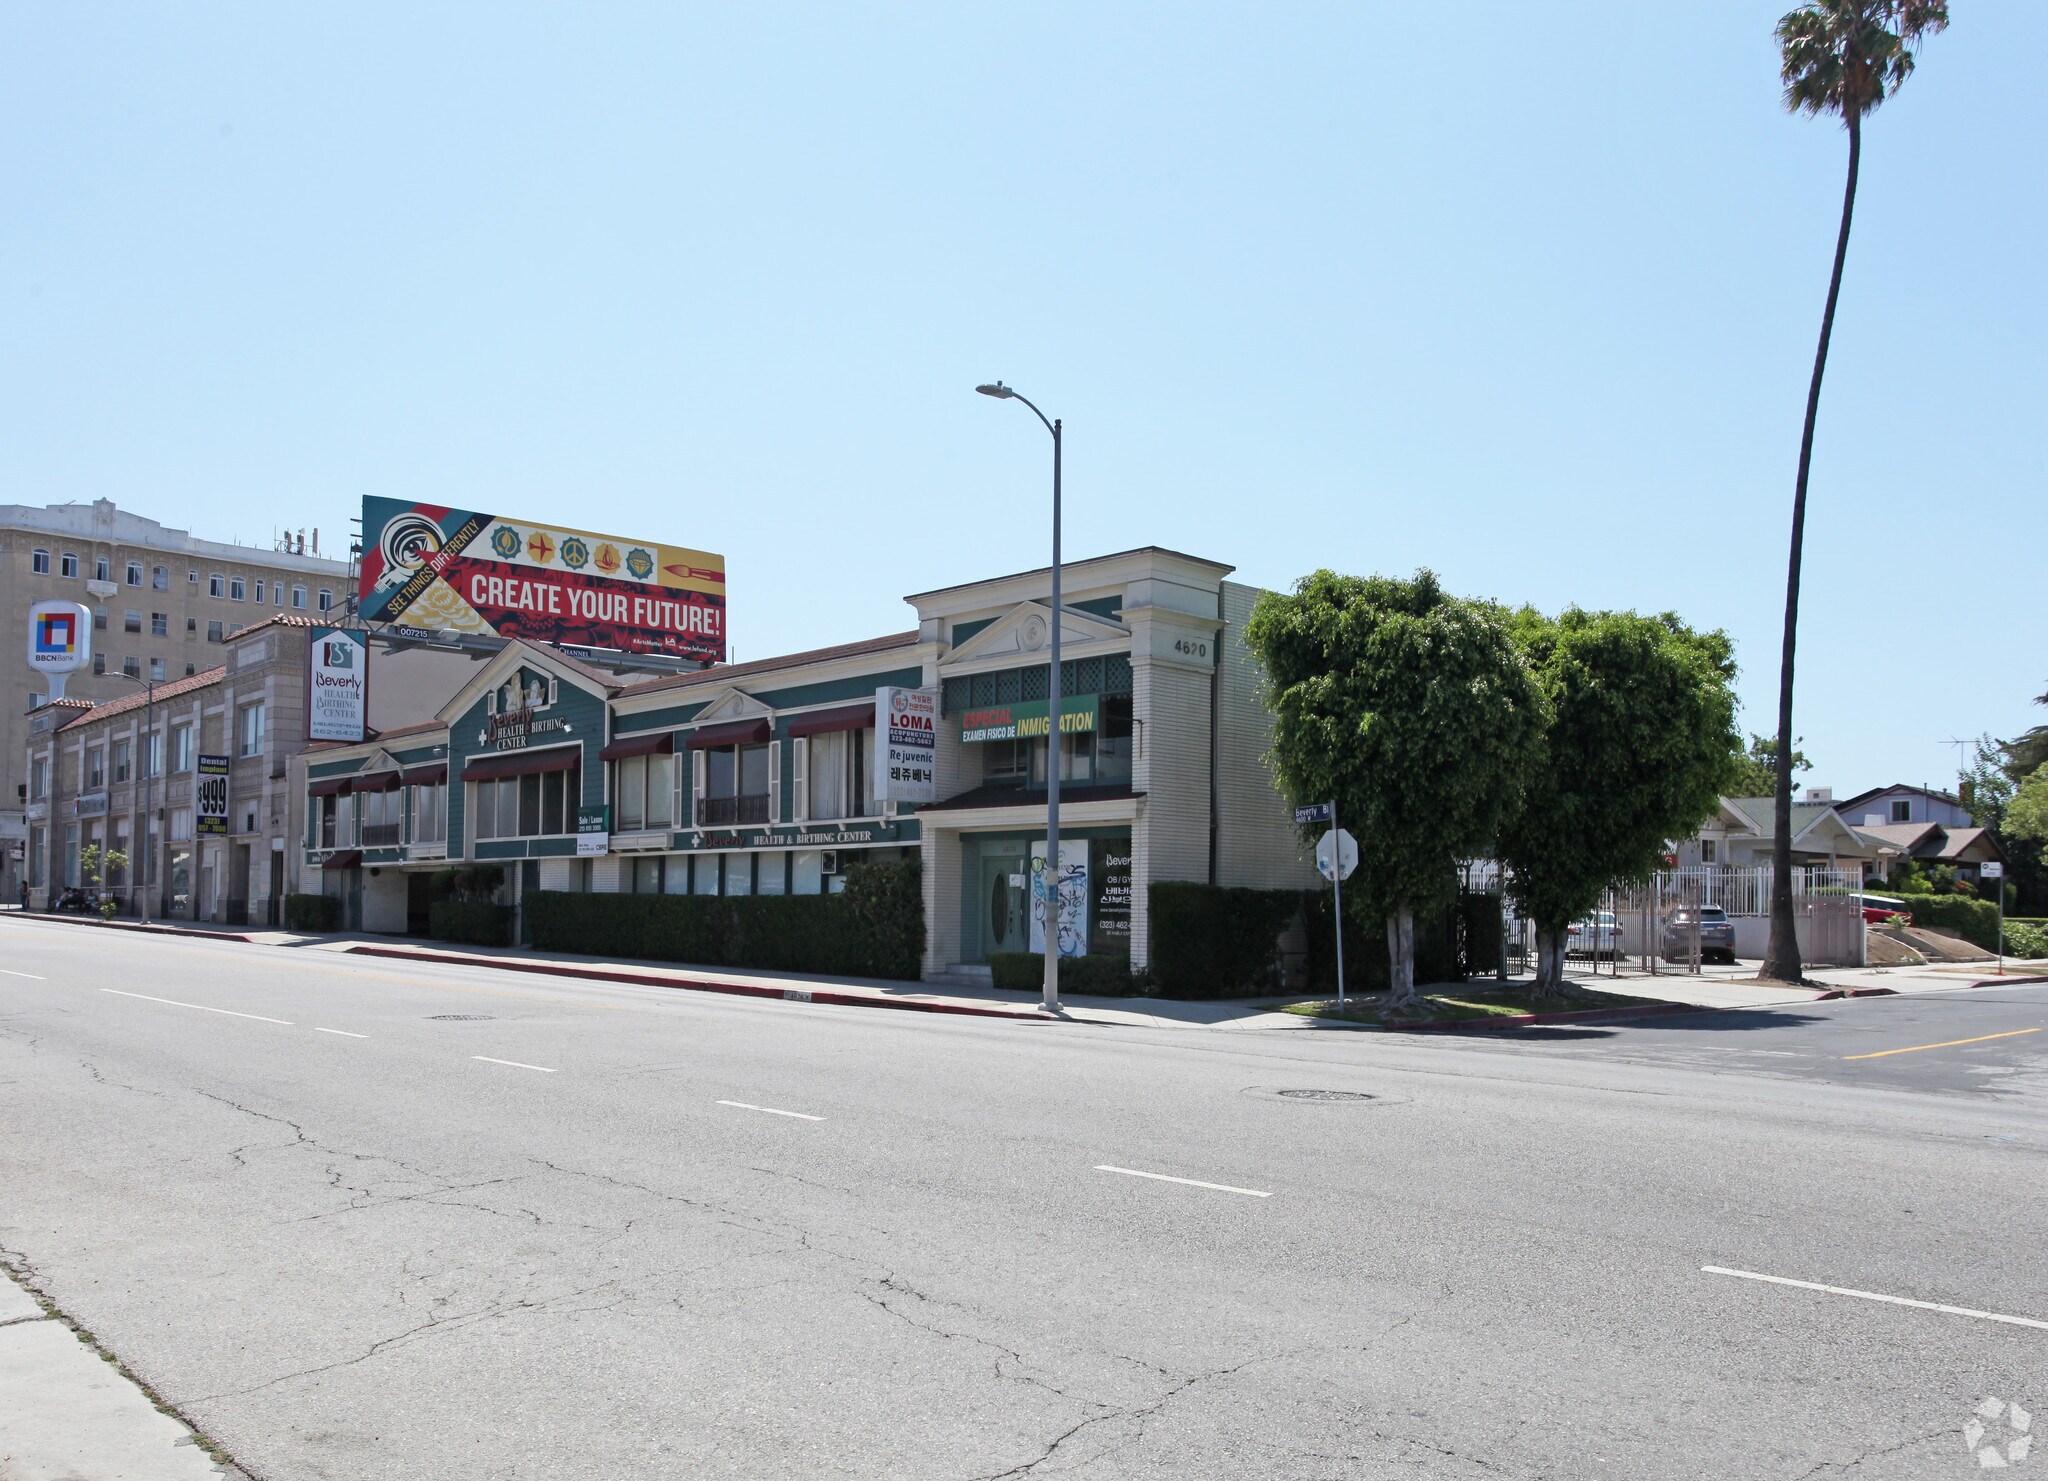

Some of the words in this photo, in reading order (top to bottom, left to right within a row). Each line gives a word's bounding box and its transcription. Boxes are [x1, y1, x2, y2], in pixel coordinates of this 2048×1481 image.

[387, 597, 408, 615] SEE
[401, 566, 436, 600] THINGS
[429, 519, 480, 572] DIFFERENTLY
[471, 574, 562, 614] CREATE
[567, 587, 628, 624] YOUR
[634, 597, 721, 636] FUTURE!
[400, 628, 428, 638] 007215
[633, 638, 663, 647] #ArtsMatter
[1175, 640, 1206, 657] 4620
[316, 671, 362, 698] Beverly
[324, 689, 356, 699] HEALTH
[316, 696, 356, 710] BIRTHING
[323, 709, 356, 719] CENTER
[963, 708, 1013, 729] ESPECIAL
[488, 706, 535, 744] Beverly
[497, 724, 524, 739] HEALTH
[531, 717, 565, 734] BIRTHING
[890, 713, 933, 731] LOMA
[1017, 711, 1093, 737] INMIGATION
[890, 729, 934, 740] ACUPUNCTURE
[963, 729, 987, 742] EXAMEN
[987, 727, 1006, 740] FISICO
[1007, 726, 1016, 738] DE
[497, 736, 527, 751] CENTER
[201, 757, 227, 766] Dental
[200, 766, 227, 774] Implant
[1296, 807, 1317, 817] Beverly
[579, 816, 588, 825] Sale
[591, 816, 603, 824] Lease
[705, 832, 745, 849] Beverly
[754, 834, 785, 846] HEALTH
[786, 837, 794, 845] &
[796, 832, 834, 845] BIRTHING
[837, 830, 872, 843] CENTER
[1099, 920, 1115, 930] (323)
